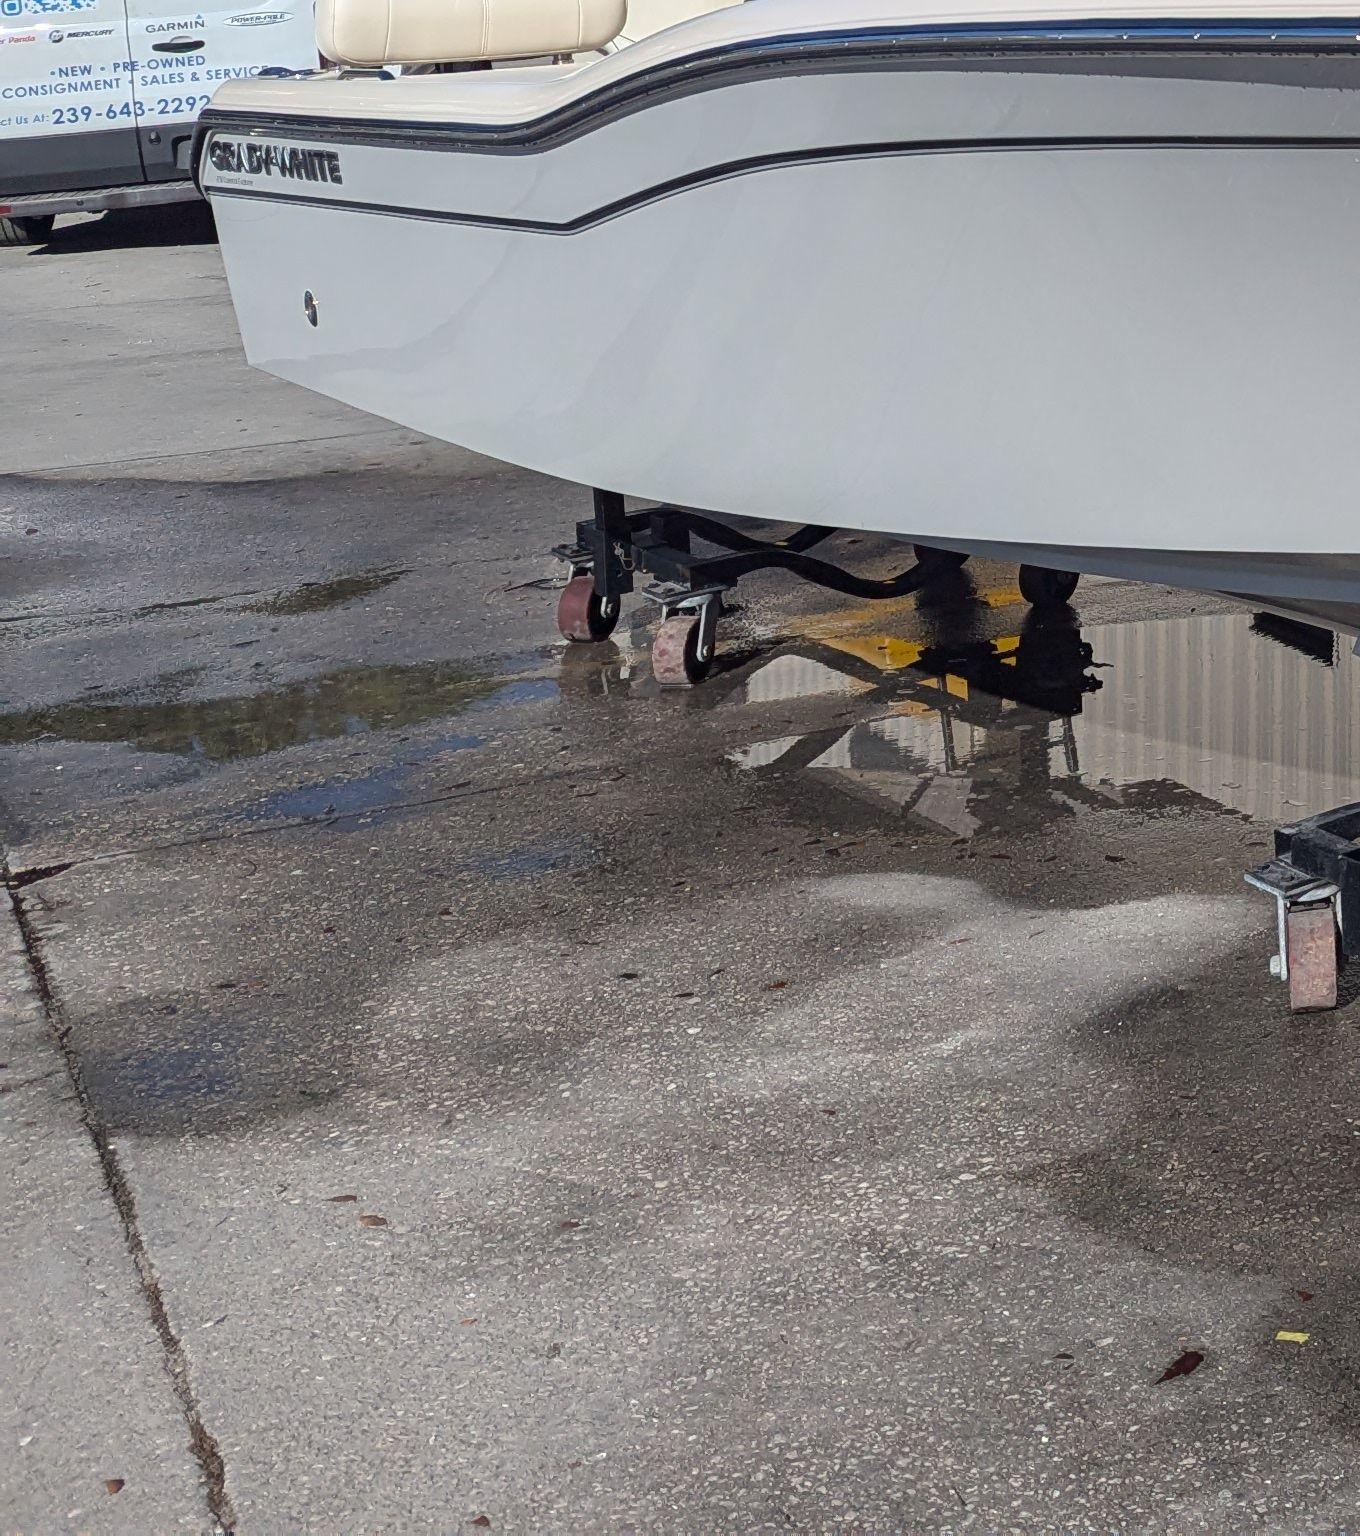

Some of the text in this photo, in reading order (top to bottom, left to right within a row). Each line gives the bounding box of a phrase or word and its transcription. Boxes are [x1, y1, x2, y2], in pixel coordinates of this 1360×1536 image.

[66, 28, 115, 39] MERCURY
[145, 19, 206, 34] GARMIN
[58, 55, 206, 78] NEW PRE-OWNED
[2, 77, 121, 99] CONSIGNMENT
[140, 73, 185, 87] SALES
[190, 72, 200, 82] &
[15, 115, 28, 125] Us
[51, 94, 211, 125] 239-643-2292
